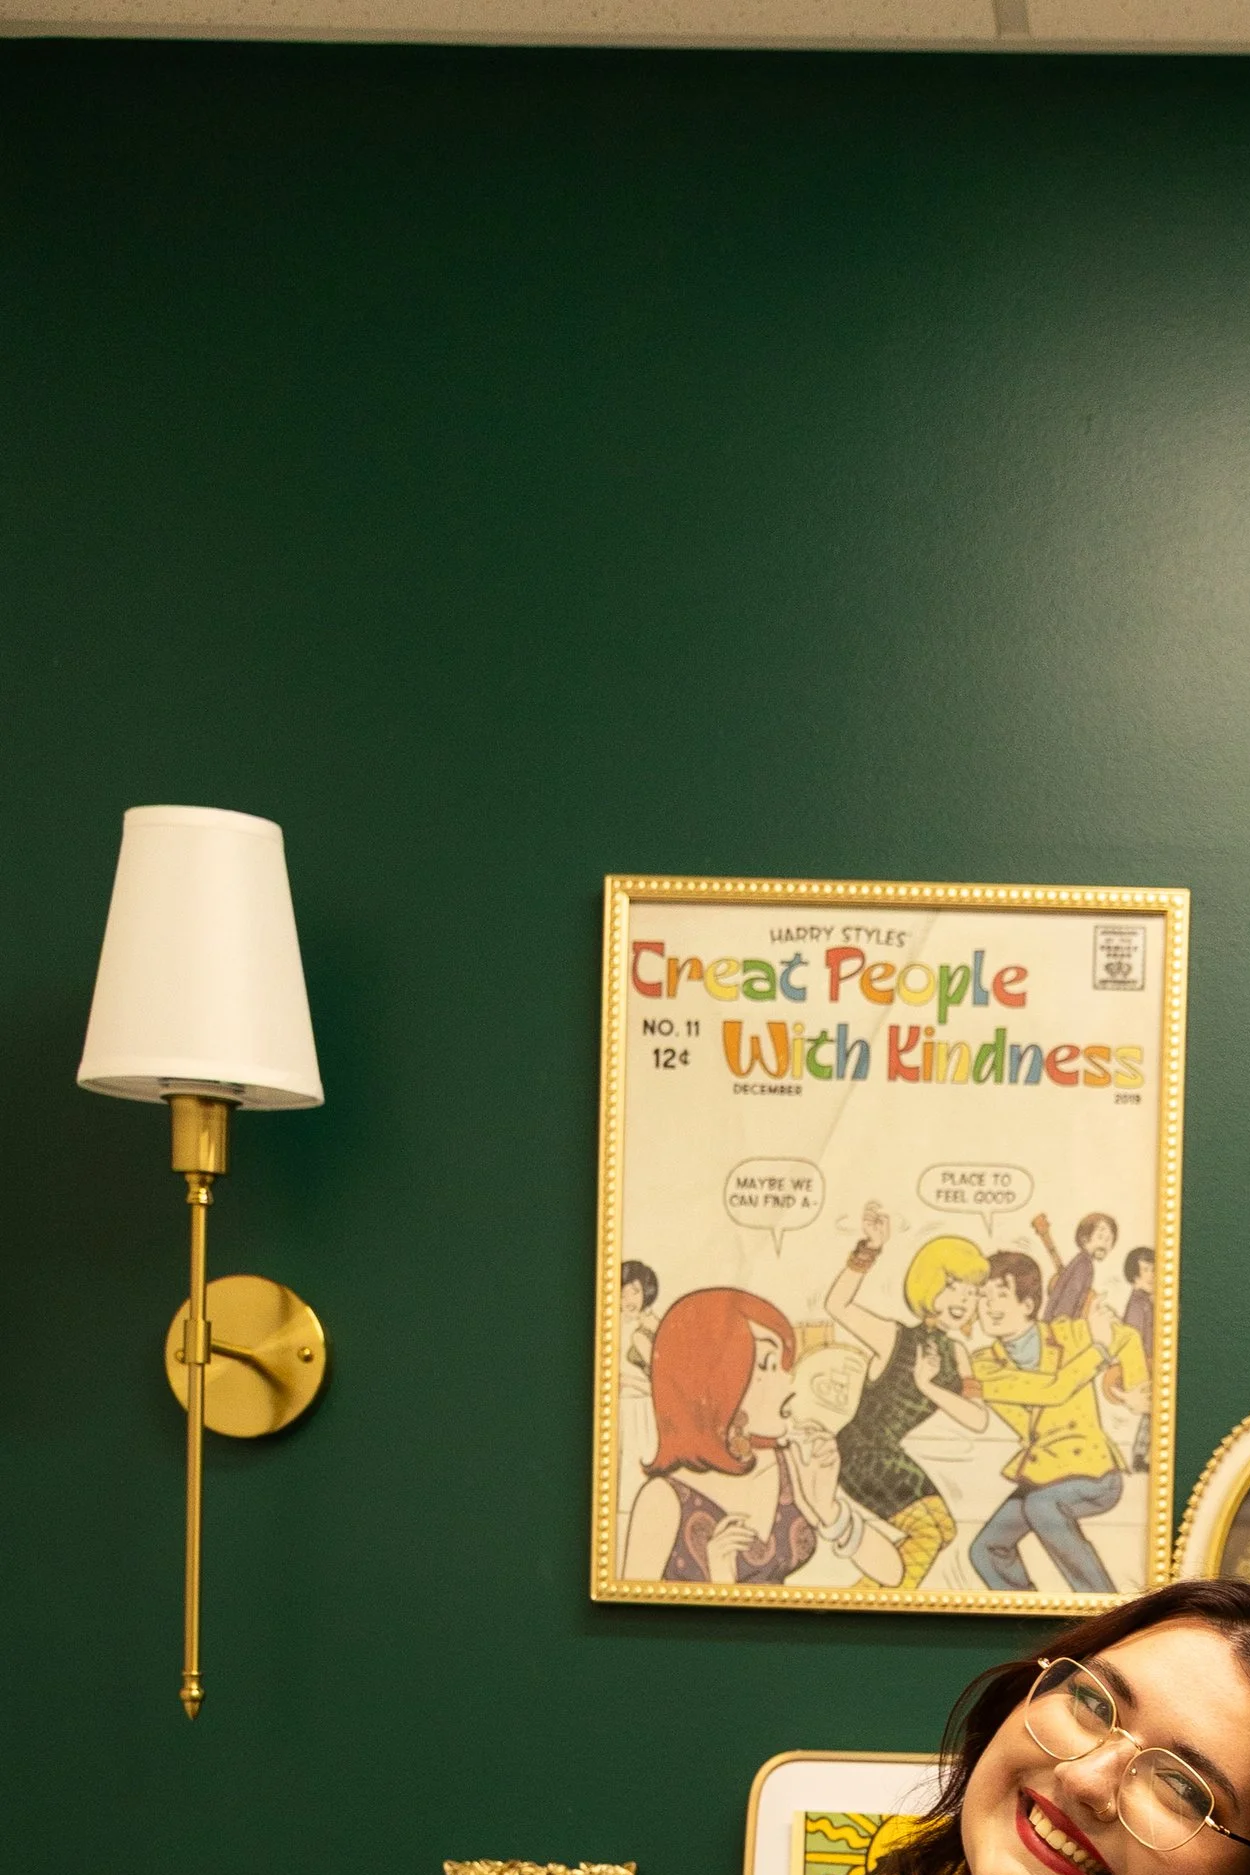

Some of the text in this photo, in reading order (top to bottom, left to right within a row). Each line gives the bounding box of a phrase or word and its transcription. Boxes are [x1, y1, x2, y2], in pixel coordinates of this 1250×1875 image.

[769, 923, 834, 944] HARRY
[824, 946, 1029, 1025] People
[642, 1018, 700, 1037] NO. 11
[653, 1047, 690, 1069] 12¢
[721, 1020, 1145, 1089] With Kindness
[732, 1083, 803, 1097] DECEMBER
[736, 1176, 812, 1192] MAYBE WE
[941, 1172, 1012, 1187] PLACE TO
[729, 1194, 759, 1208] CAN
[763, 1194, 797, 1208] FIND
[936, 1189, 1017, 1204] FEEL GOOD
